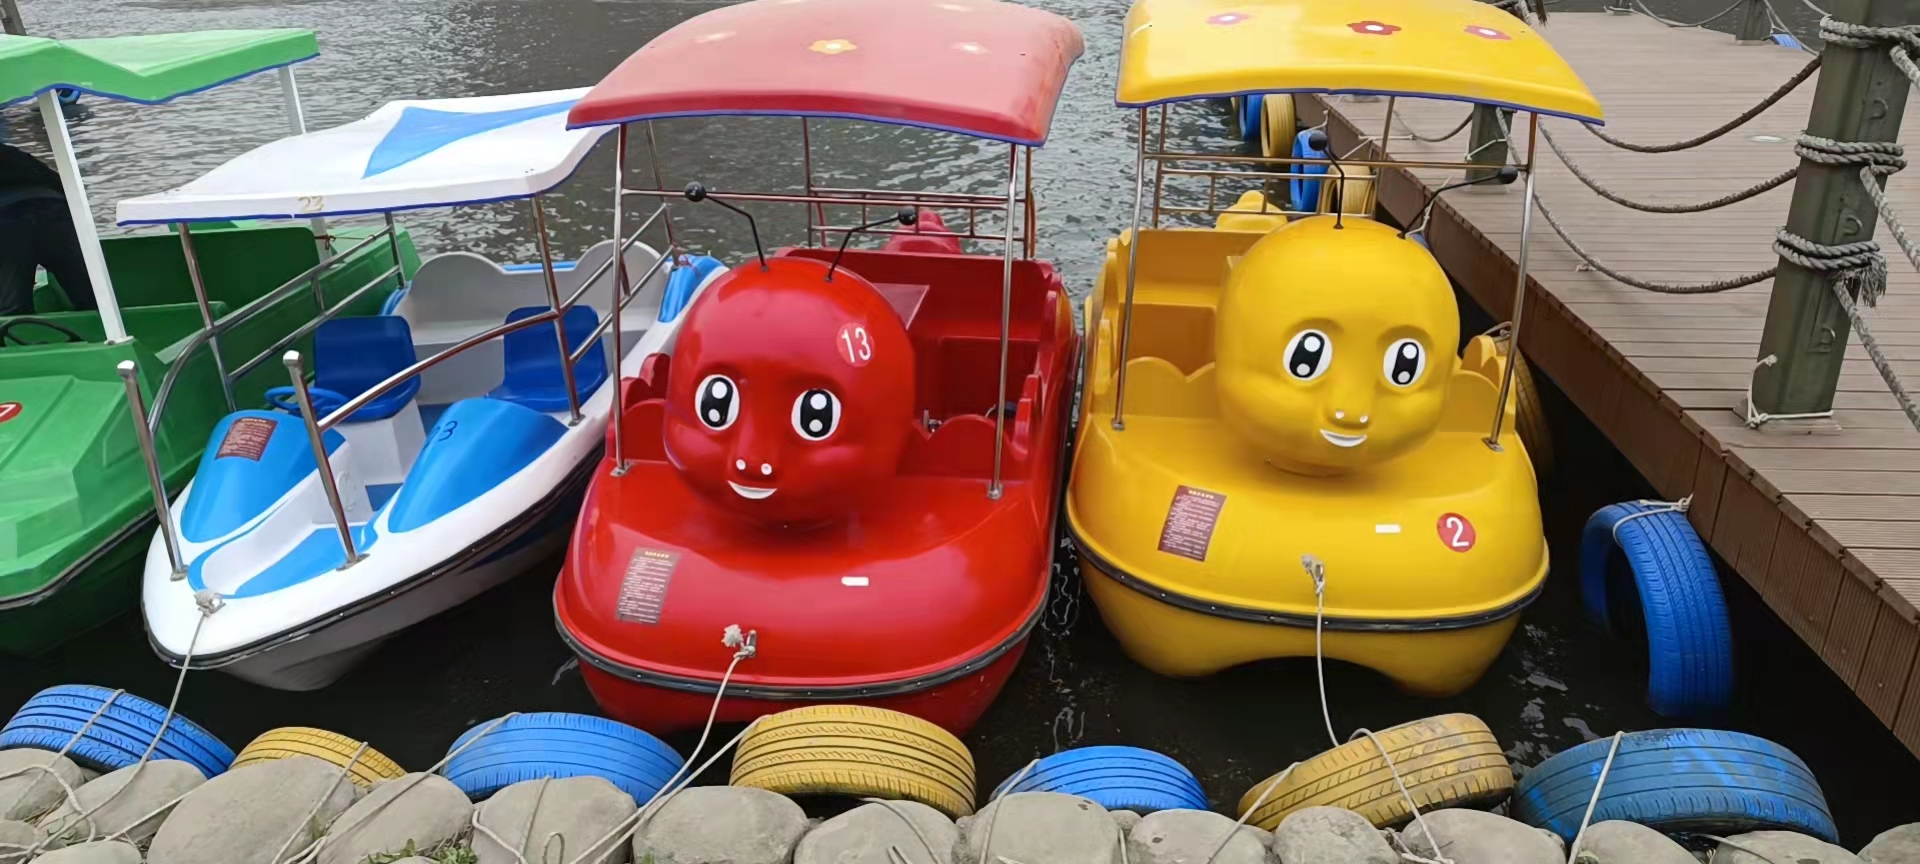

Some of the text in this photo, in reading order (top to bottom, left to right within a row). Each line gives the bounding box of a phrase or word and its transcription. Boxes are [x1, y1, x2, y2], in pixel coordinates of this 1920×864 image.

[297, 195, 325, 213] 23
[841, 327, 872, 363] 13
[1446, 516, 1470, 548] 2
